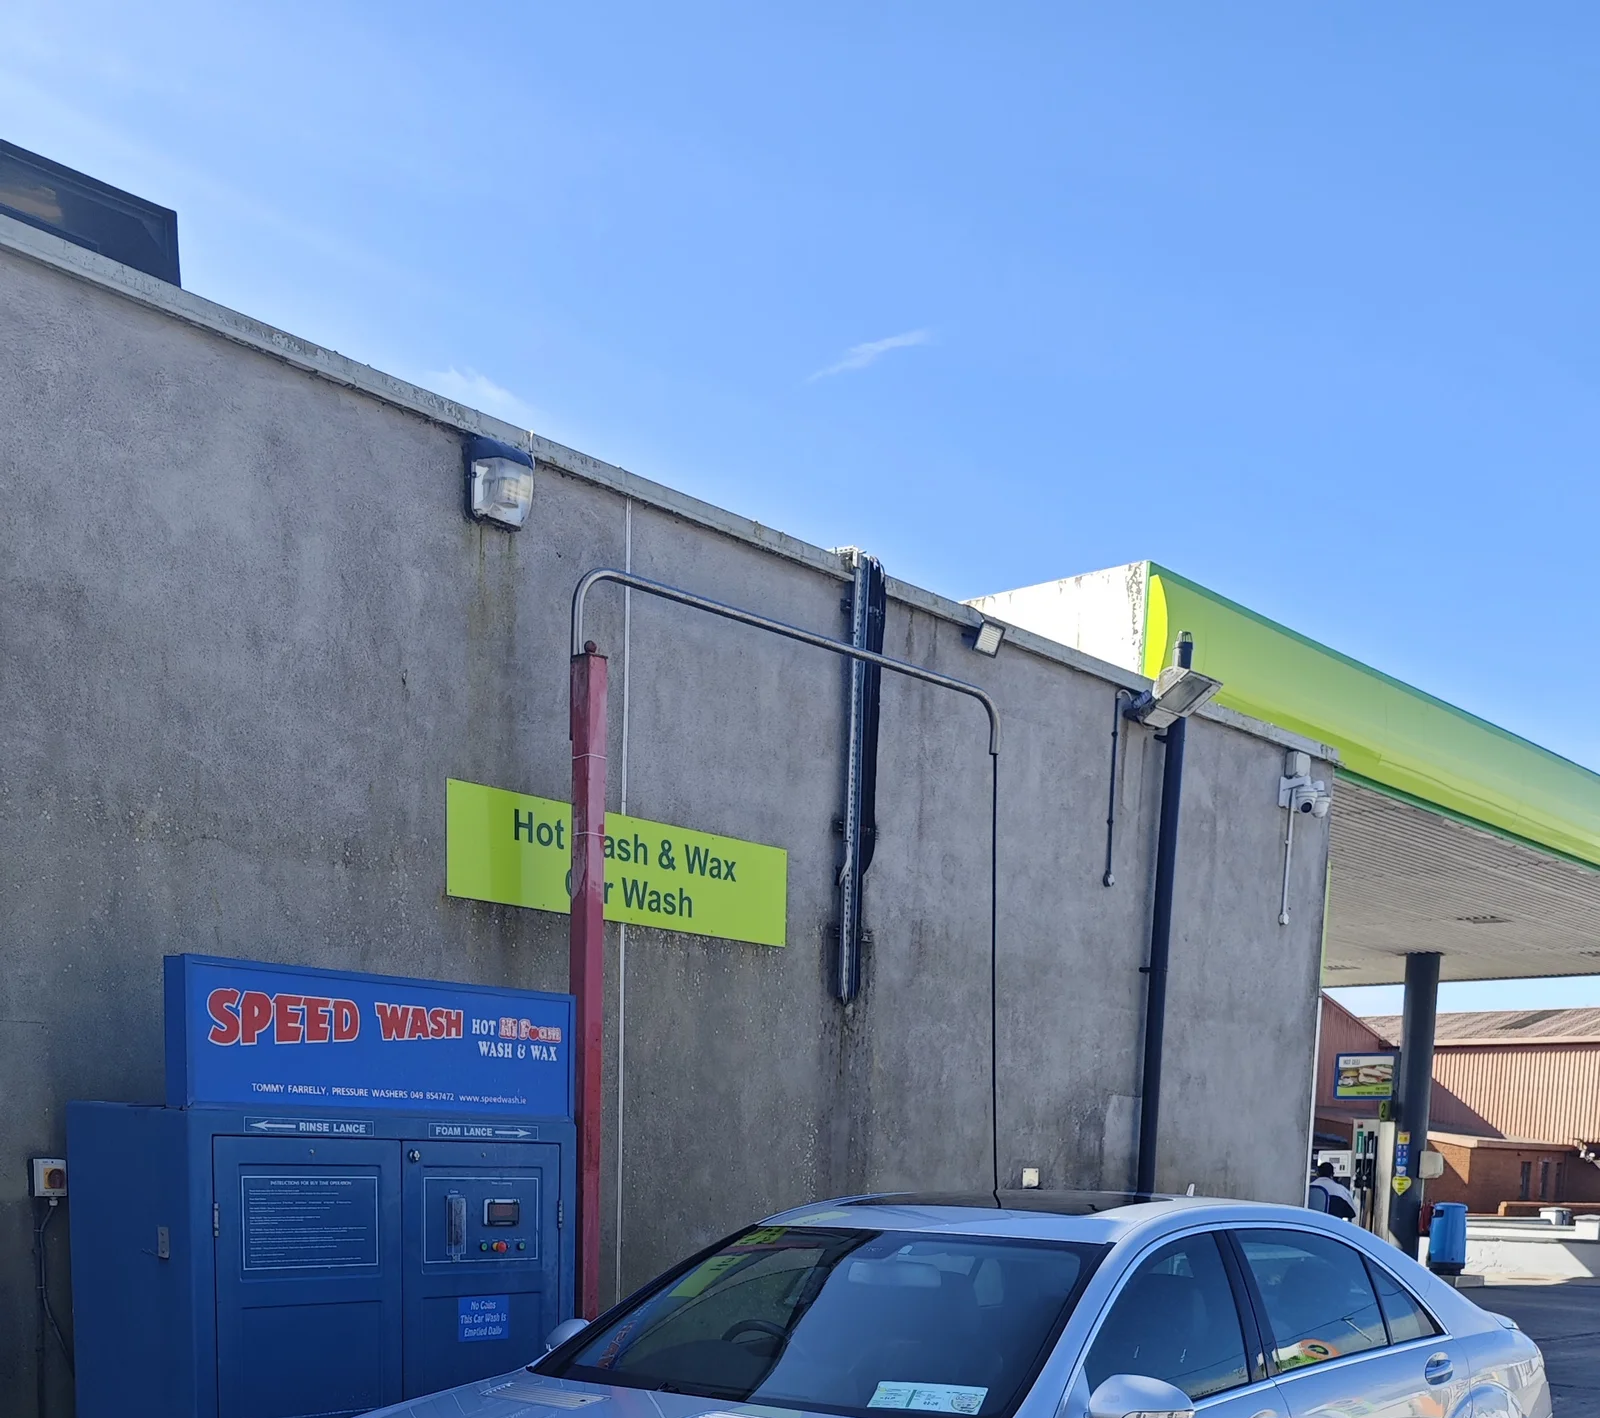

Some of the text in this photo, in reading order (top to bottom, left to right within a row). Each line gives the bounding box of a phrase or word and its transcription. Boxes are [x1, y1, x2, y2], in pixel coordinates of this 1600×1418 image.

[514, 808, 738, 882] Hot ash & Wax
[621, 877, 694, 918] Wash
[206, 987, 464, 1047] SPEED WASH
[471, 1018, 497, 1036] HOT
[498, 1017, 518, 1040] Hi
[478, 1041, 557, 1062] WASH & WAX
[251, 1083, 527, 1105] TOMMY FARRELLY, PRESSURE WASHERS 049 8547472 www.speedwash.ie
[1381, 1102, 1387, 1118] 2
[299, 1122, 366, 1134] RINSE LANCE
[435, 1126, 493, 1137] FOAM LANCE
[470, 1300, 480, 1311] No
[460, 1314, 473, 1325] This
[473, 1313, 484, 1324] Car
[484, 1312, 500, 1323] Wash
[464, 1325, 503, 1338] Emptied Daily
